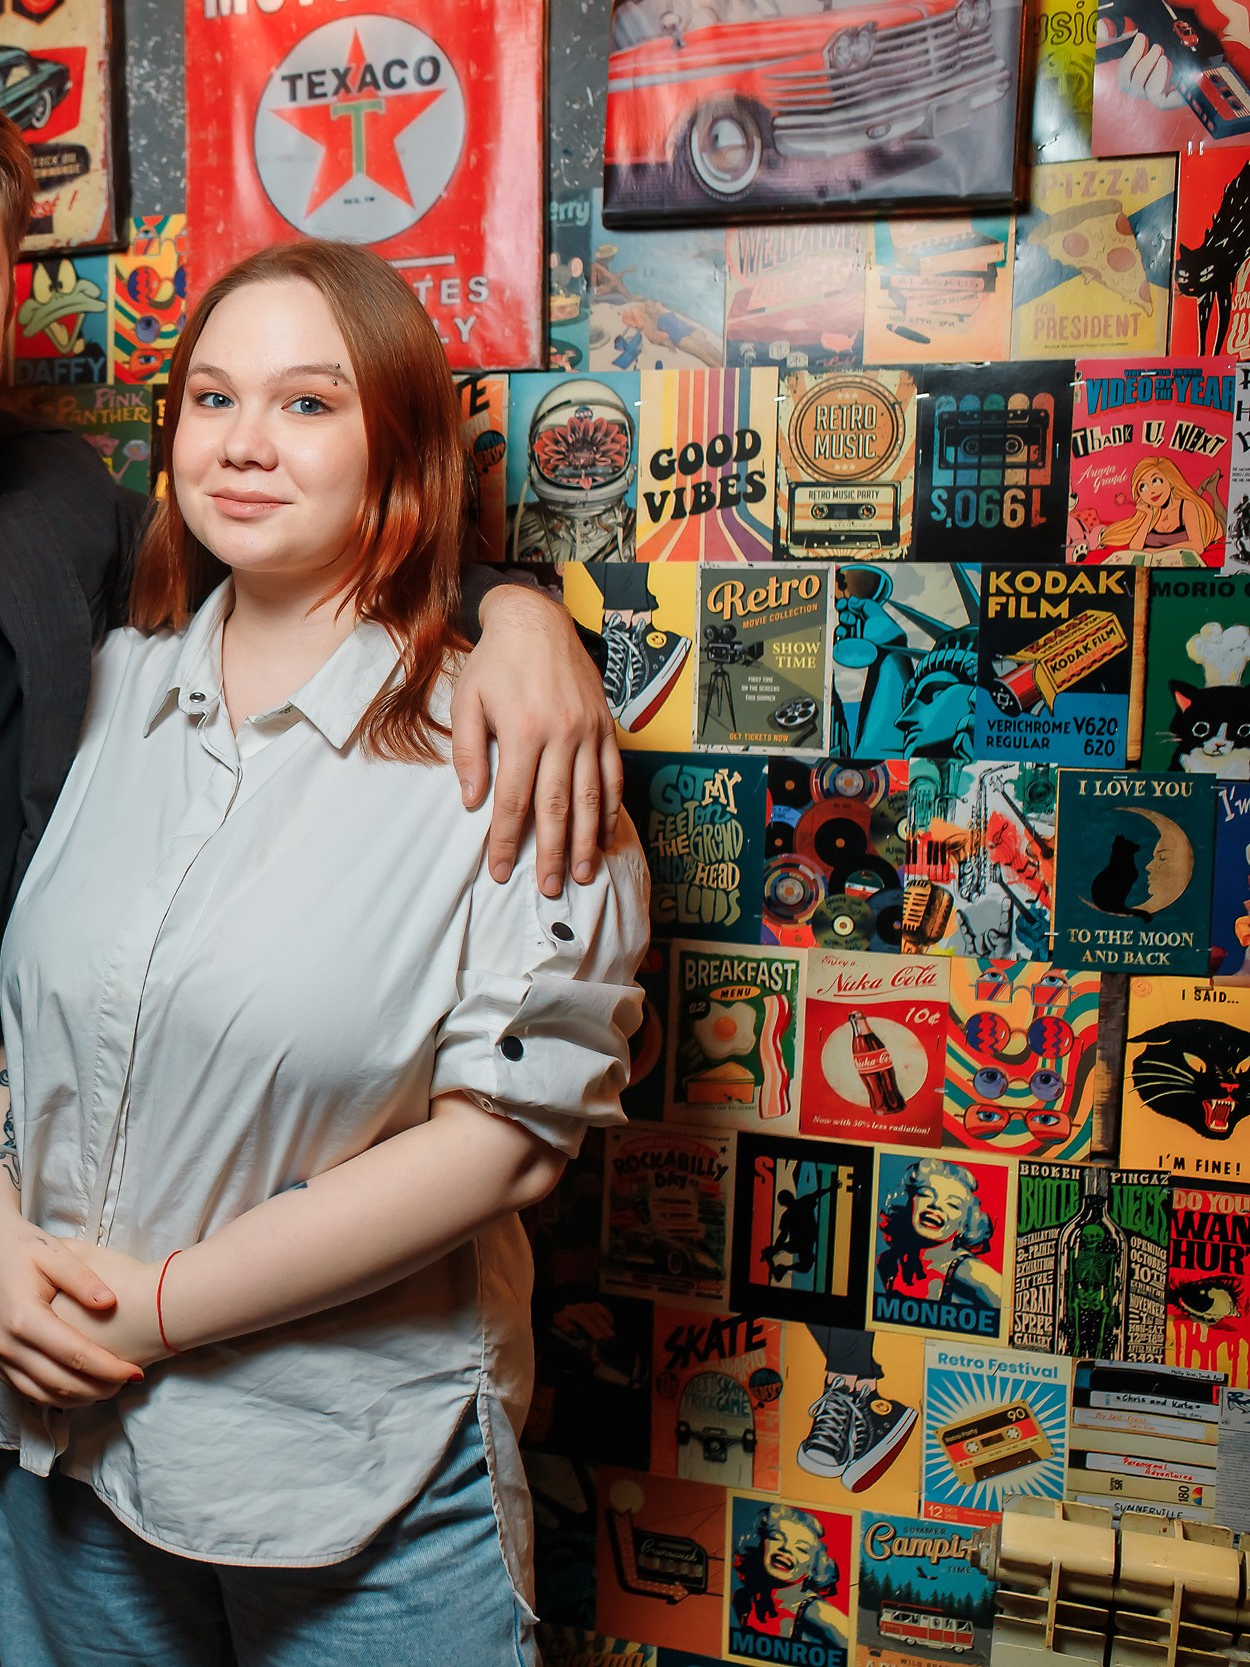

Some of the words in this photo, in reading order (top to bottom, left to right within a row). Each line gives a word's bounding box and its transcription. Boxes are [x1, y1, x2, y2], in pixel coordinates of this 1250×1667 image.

[281, 55, 441, 103] TEXACO
[330, 99, 386, 177] T
[1034, 311, 1142, 342] PRESIDENT
[17, 357, 106, 385] DAFFY
[1086, 376, 1153, 415] VIDEO
[1155, 377, 1173, 389] OF
[1174, 375, 1236, 414] YEAR
[1155, 388, 1173, 401] THE
[814, 403, 878, 431] RETRO
[649, 428, 762, 481] GOOD
[813, 432, 878, 460] MUSIC
[643, 469, 768, 524] VIBES
[808, 489, 831, 500] RETRO
[832, 489, 855, 500] MUSIC
[856, 489, 880, 500] PARTY
[989, 570, 1126, 595] KODAK
[1151, 581, 1236, 598] MORIO
[706, 573, 822, 622] Retro
[987, 596, 1070, 619] FILM
[741, 613, 768, 629] MOVIE
[769, 603, 819, 623] COLLECTION
[772, 641, 821, 655] SHOW
[1050, 643, 1092, 674] KODAK
[1091, 627, 1117, 648] FILM
[776, 656, 817, 669] TIME
[987, 719, 1071, 735] VERICHROME
[1073, 716, 1119, 737] V620
[986, 735, 1050, 750] REGULAR
[1083, 739, 1116, 757] 620
[702, 768, 743, 815] MY
[1078, 780, 1087, 795] I
[1093, 780, 1146, 797] LOVE
[1151, 780, 1195, 798] YOU
[1068, 929, 1092, 944] TO
[1094, 929, 1134, 946] THE
[1138, 931, 1195, 948] MOON
[1080, 949, 1119, 964] AND
[1123, 951, 1172, 966] BACK
[685, 958, 797, 992] BREAKFAST
[816, 972, 883, 996] Nuka
[890, 964, 938, 988] Cola
[720, 987, 752, 999] MENU
[1181, 989, 1186, 1000] I
[1194, 989, 1240, 1005] SAID...
[812, 1116, 830, 1125] Now
[832, 1118, 851, 1127] with
[871, 1121, 887, 1131] less
[888, 1123, 931, 1135] radiation!
[612, 1151, 729, 1182] ROCKABILLY
[753, 1156, 855, 1194] SKATE
[1019, 1163, 1081, 1180] BROKEN
[1158, 1153, 1186, 1170] I'M
[1195, 1157, 1242, 1176] FINE!
[654, 1171, 690, 1190] DAY
[1018, 1177, 1080, 1234] BOTTLE
[1110, 1185, 1170, 1248] NECK
[1172, 1189, 1203, 1211] DO
[1207, 1193, 1250, 1215] YOU
[1017, 1250, 1028, 1262] &
[1028, 1241, 1056, 1260] PRINTS
[1130, 1236, 1167, 1262] OPENING
[1171, 1240, 1250, 1275] HUR
[1016, 1256, 1055, 1278] EXHIBITION
[1130, 1250, 1167, 1274] OCTOBER
[1021, 1275, 1032, 1287] AT
[1032, 1272, 1049, 1285] THE
[1015, 1285, 1053, 1315] URBAN
[876, 1297, 996, 1334] MONROE
[663, 1311, 768, 1370] SKATE
[1013, 1333, 1052, 1349] GALLERY
[937, 1352, 985, 1370] Retro
[989, 1358, 1059, 1379] Festival
[1121, 1394, 1146, 1404] Chris
[1149, 1398, 1167, 1407] and
[1007, 1408, 1026, 1422] 90
[1123, 1457, 1168, 1471] Paranormal
[1144, 1468, 1193, 1481] Adventures
[1178, 1485, 1190, 1502] 180
[927, 1504, 945, 1519] 12
[1114, 1502, 1184, 1520] SUMMERVILLE
[902, 1526, 948, 1535] SUMMER
[864, 1521, 972, 1566] Campi
[947, 1565, 973, 1574] TIME
[731, 1632, 844, 1667] MONROE
